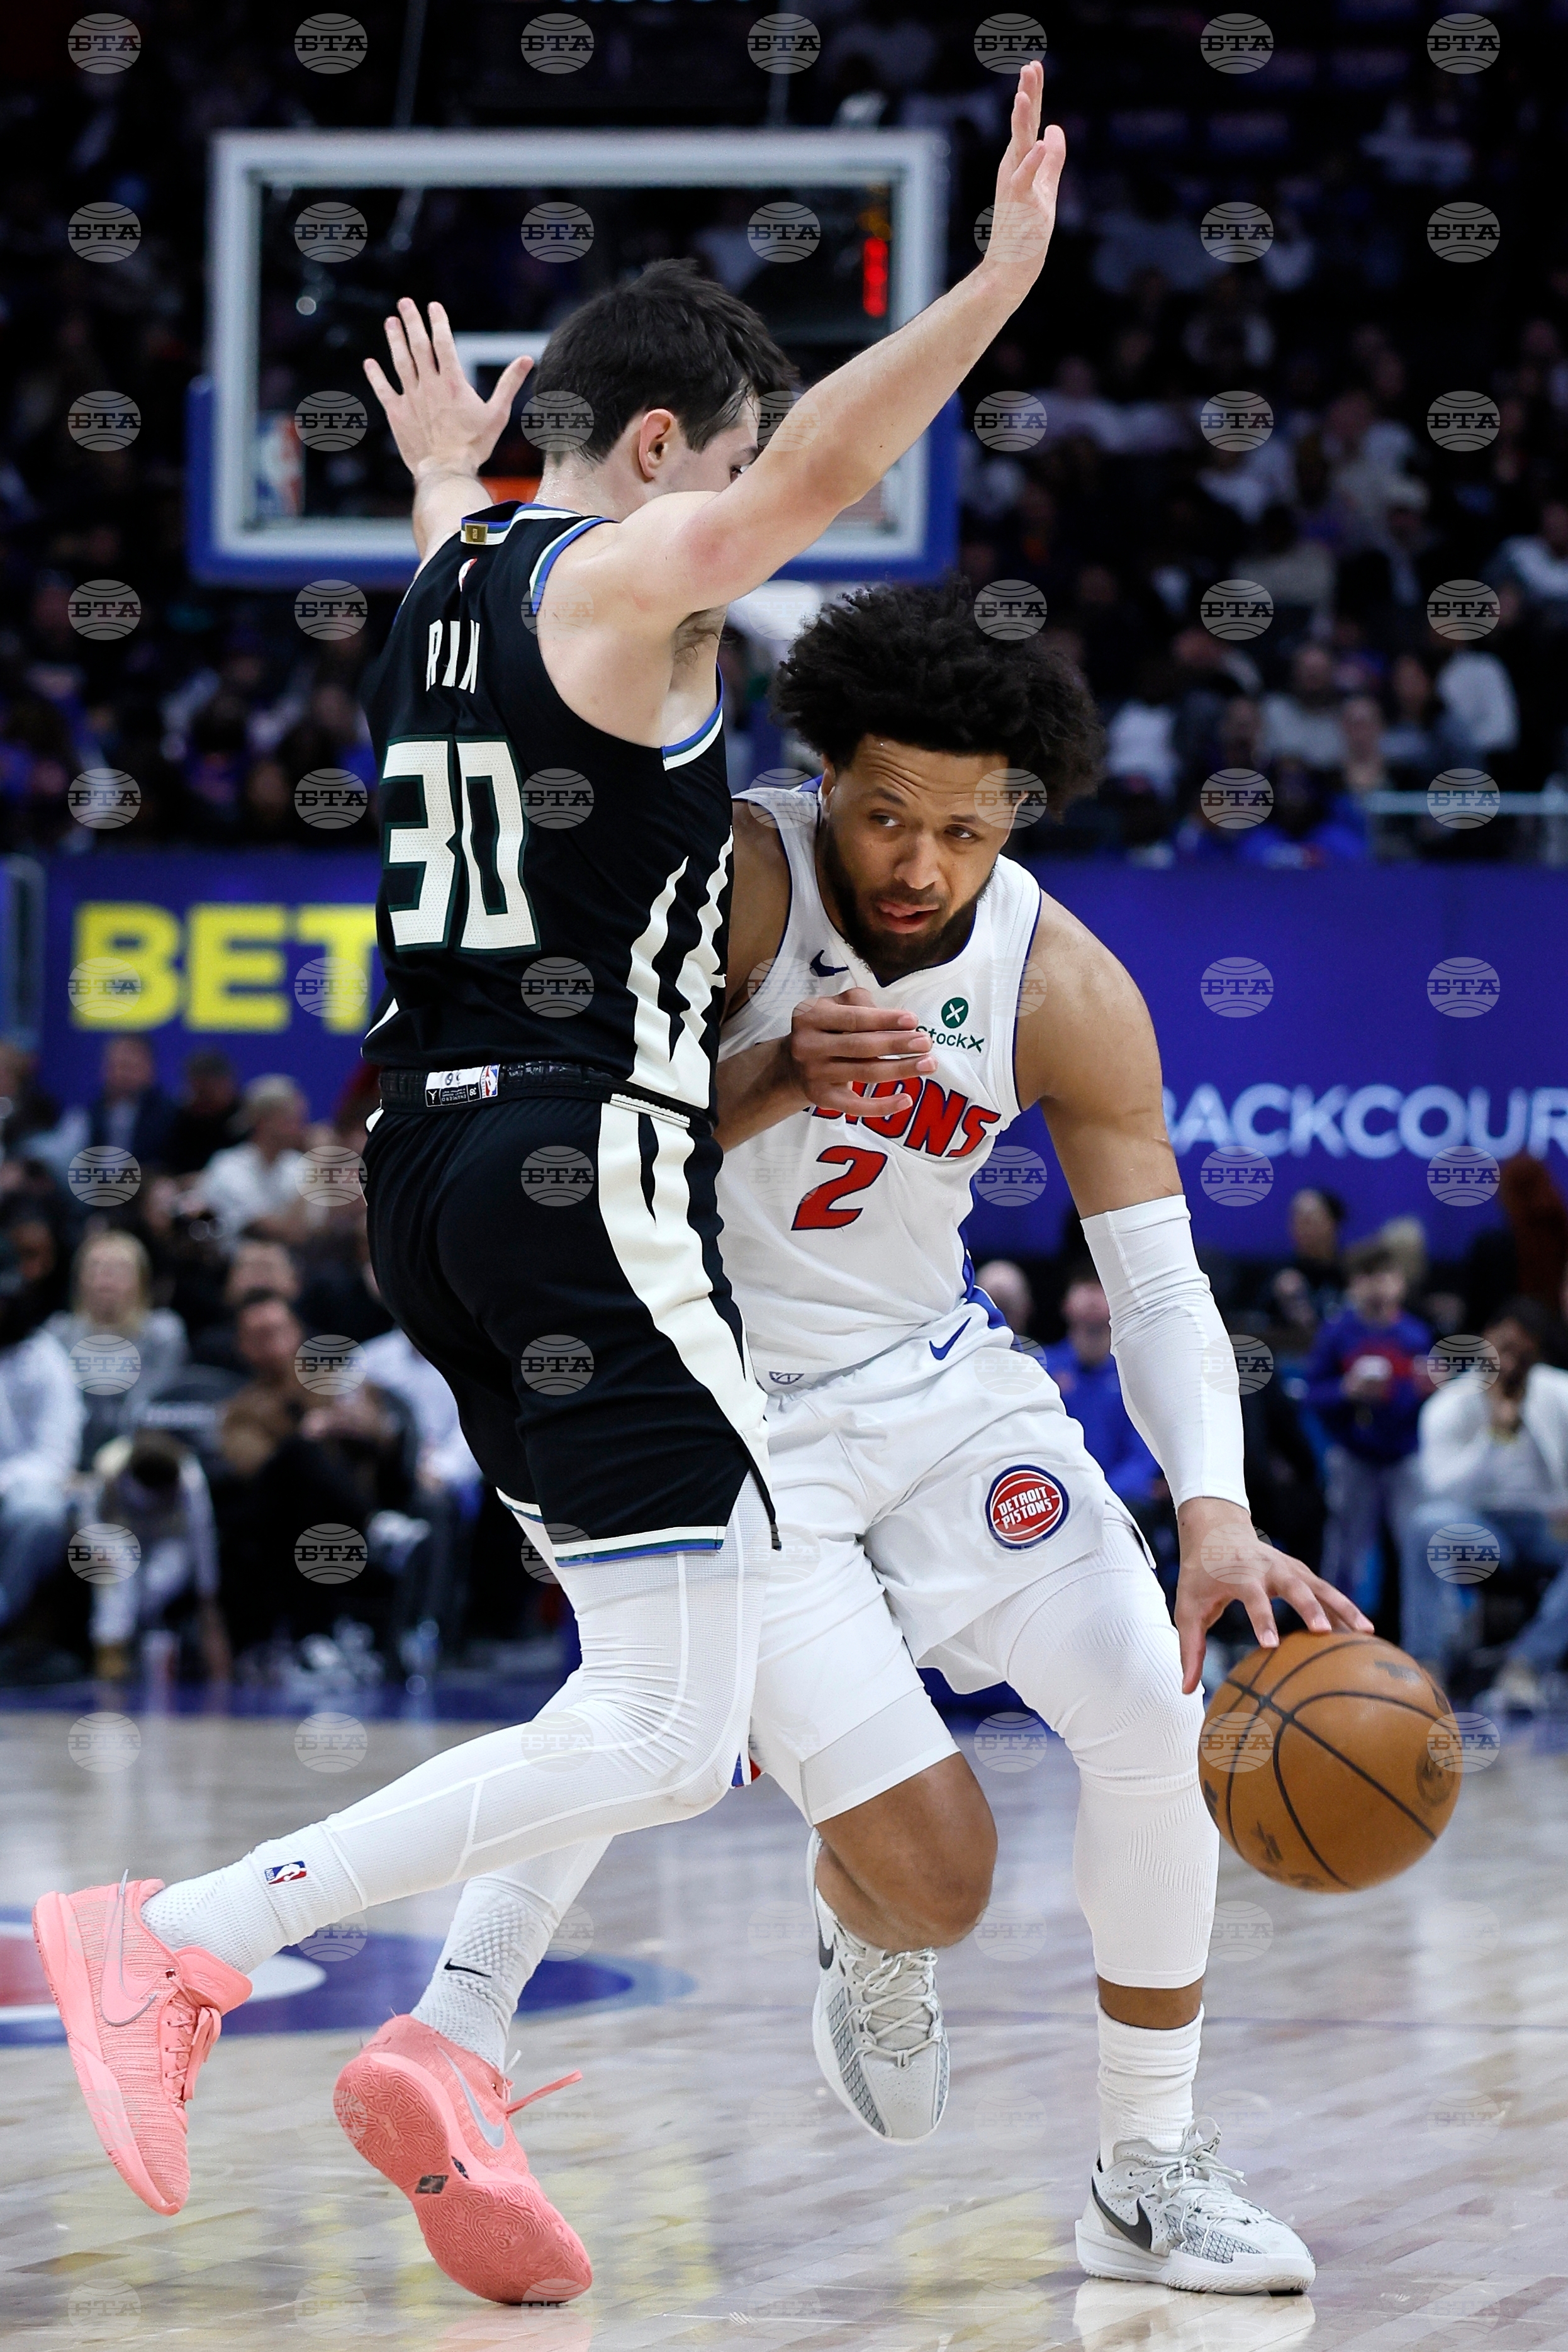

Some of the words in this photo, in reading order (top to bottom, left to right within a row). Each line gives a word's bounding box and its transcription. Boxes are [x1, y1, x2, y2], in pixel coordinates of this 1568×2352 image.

[381, 735, 540, 955] 30
[791, 1145, 888, 1231] 2
[997, 1486, 1048, 1517] DETROIT
[1001, 1498, 1053, 1530] PISTONS
